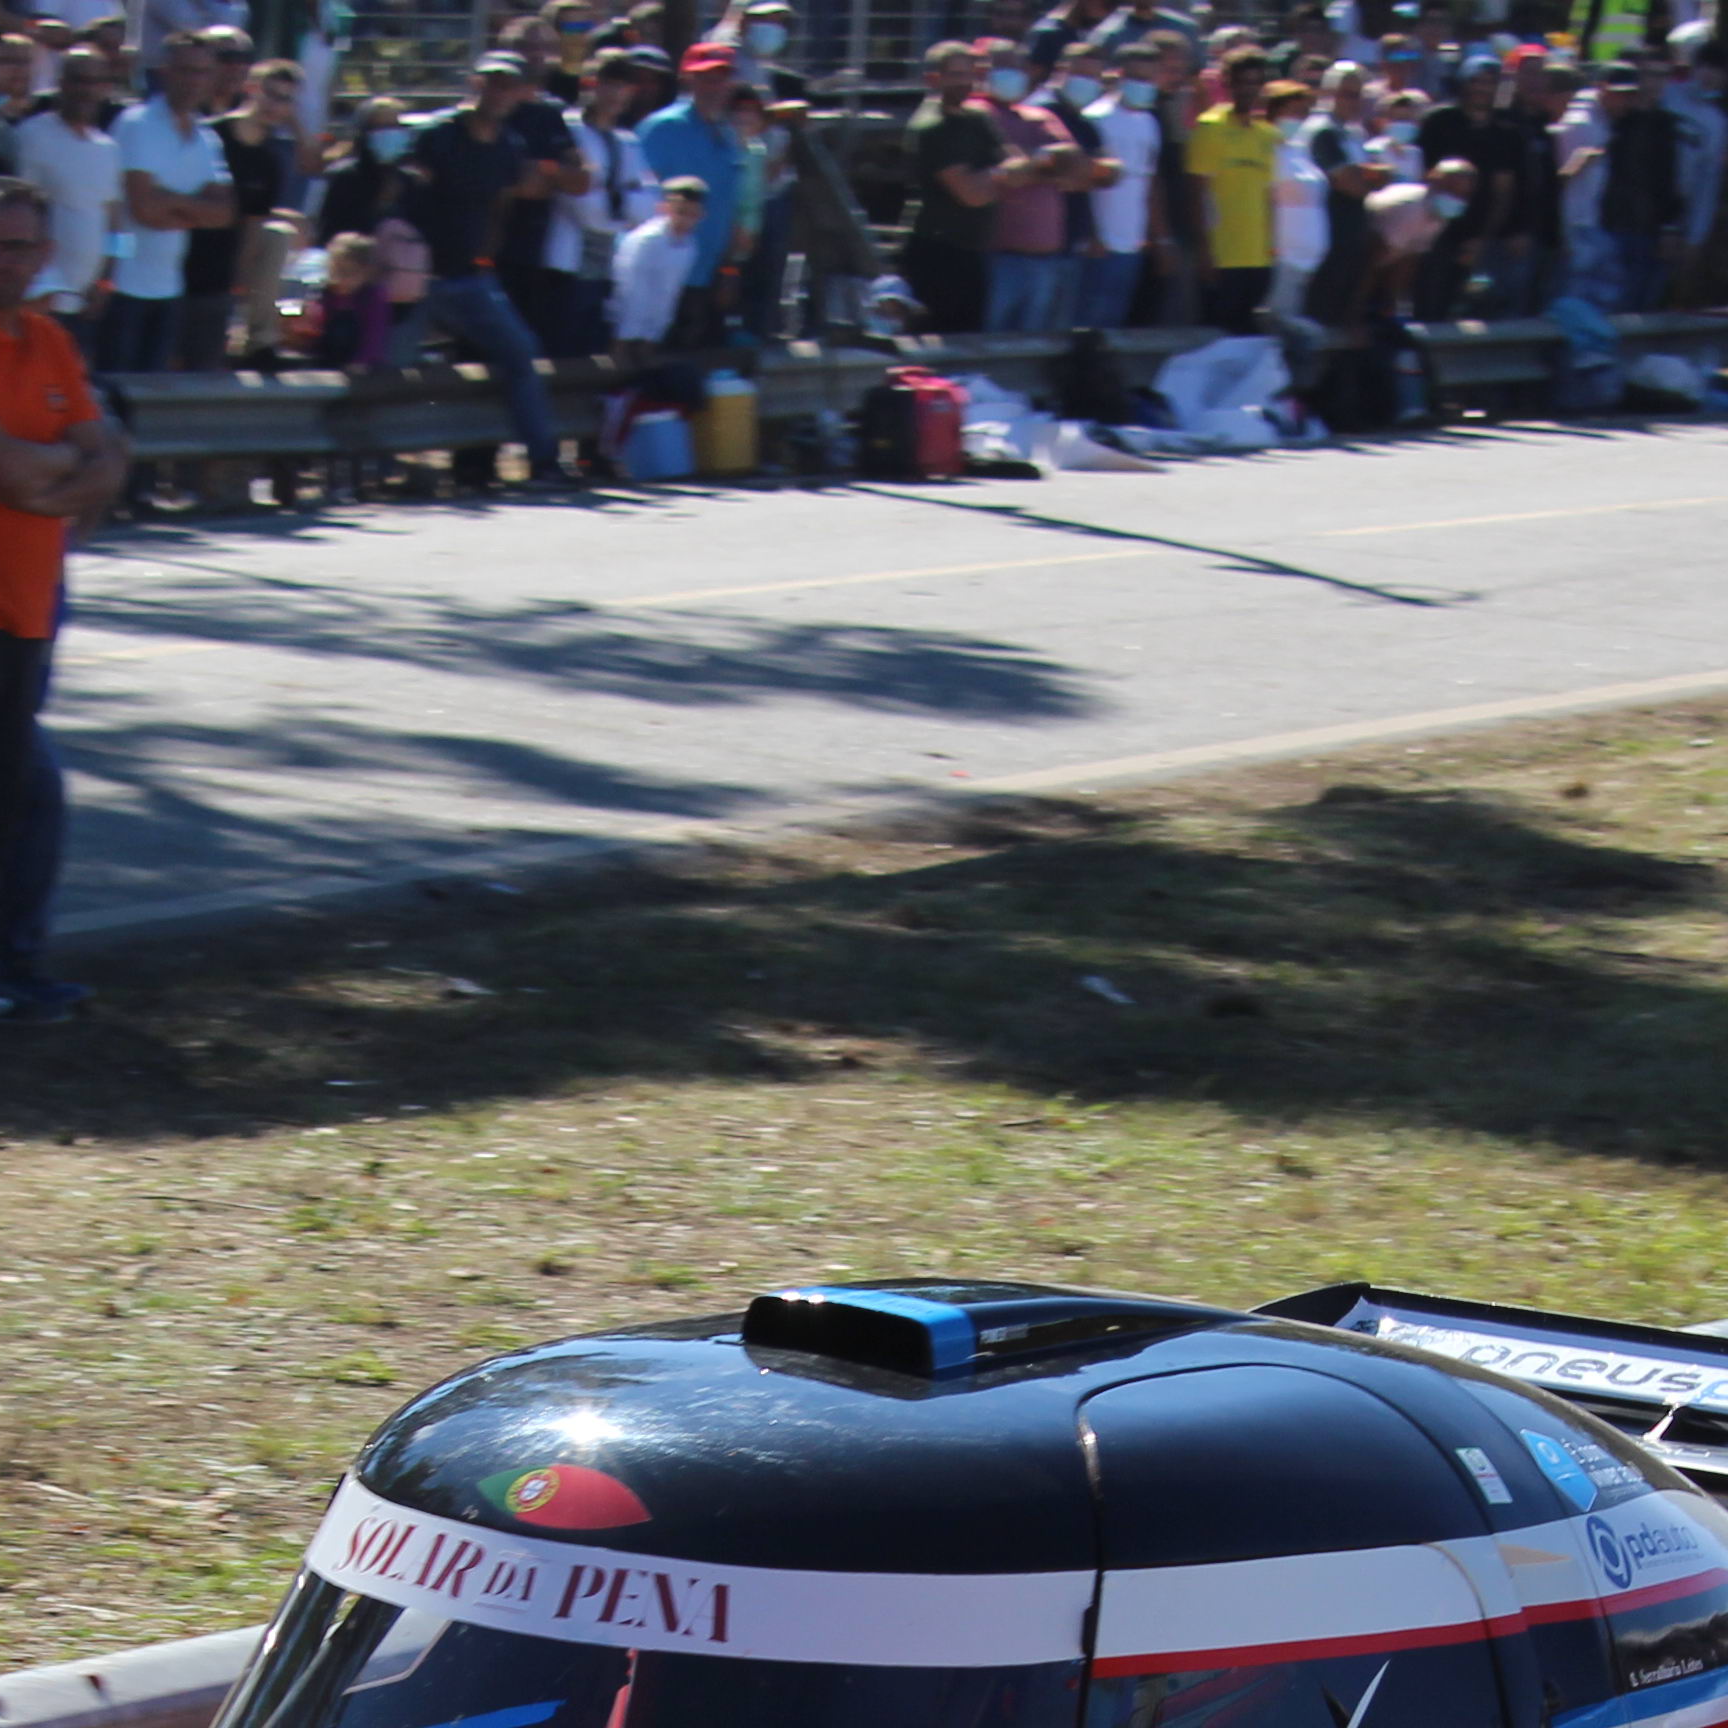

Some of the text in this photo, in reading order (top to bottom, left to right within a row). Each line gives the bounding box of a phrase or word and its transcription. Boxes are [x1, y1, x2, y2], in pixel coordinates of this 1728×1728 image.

[334, 1514, 731, 1644] SOLAR DA PENA
[1628, 1523, 1699, 1563] pdauto
